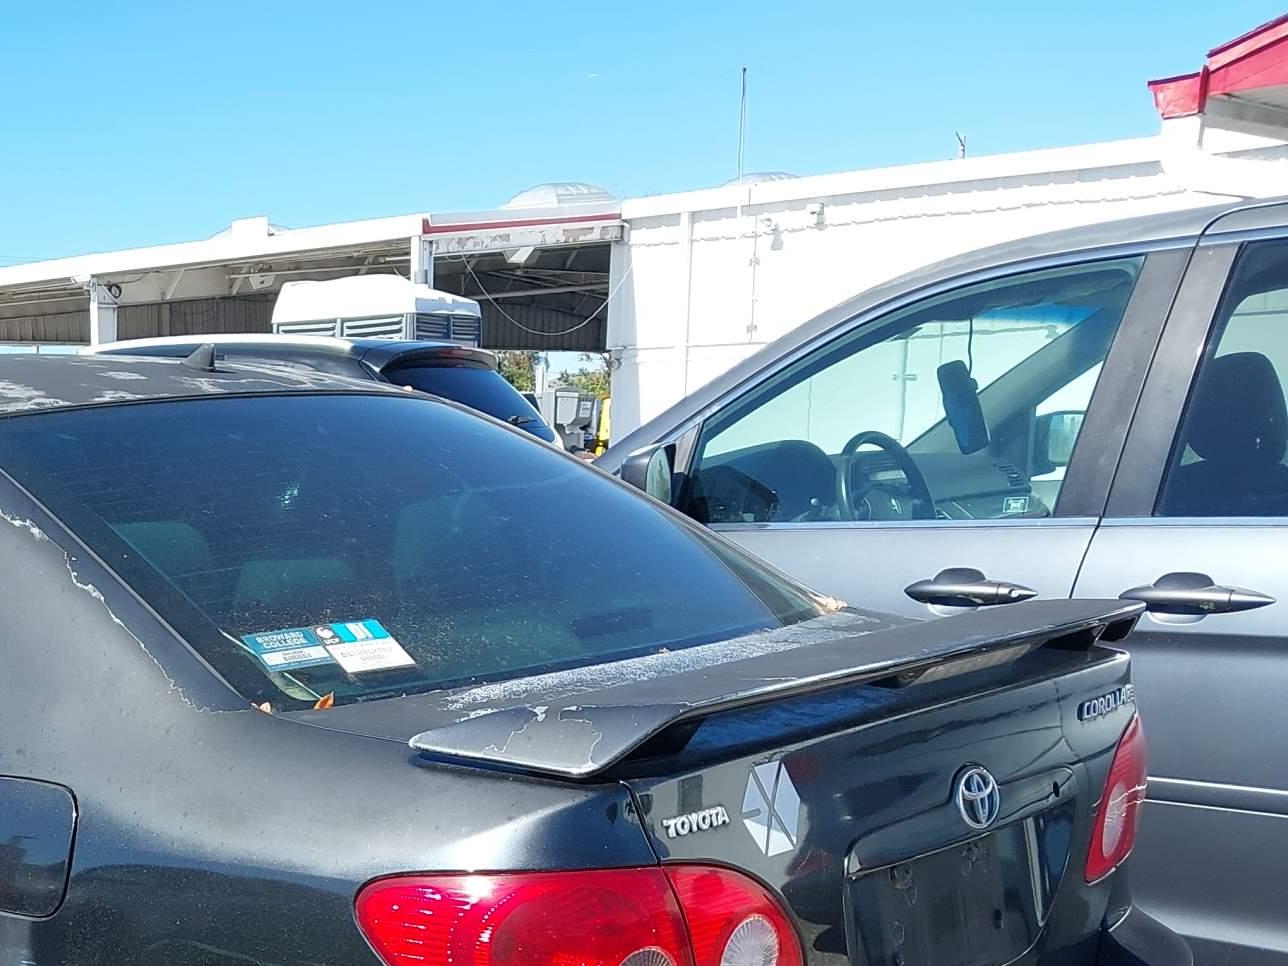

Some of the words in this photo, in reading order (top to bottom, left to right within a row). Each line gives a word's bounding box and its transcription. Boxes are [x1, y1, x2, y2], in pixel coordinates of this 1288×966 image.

[255, 631, 304, 644] BROWARD
[263, 637, 309, 649] COLLEGE
[1084, 687, 1127, 718] COROLLA
[662, 806, 730, 838] TOYOTA
